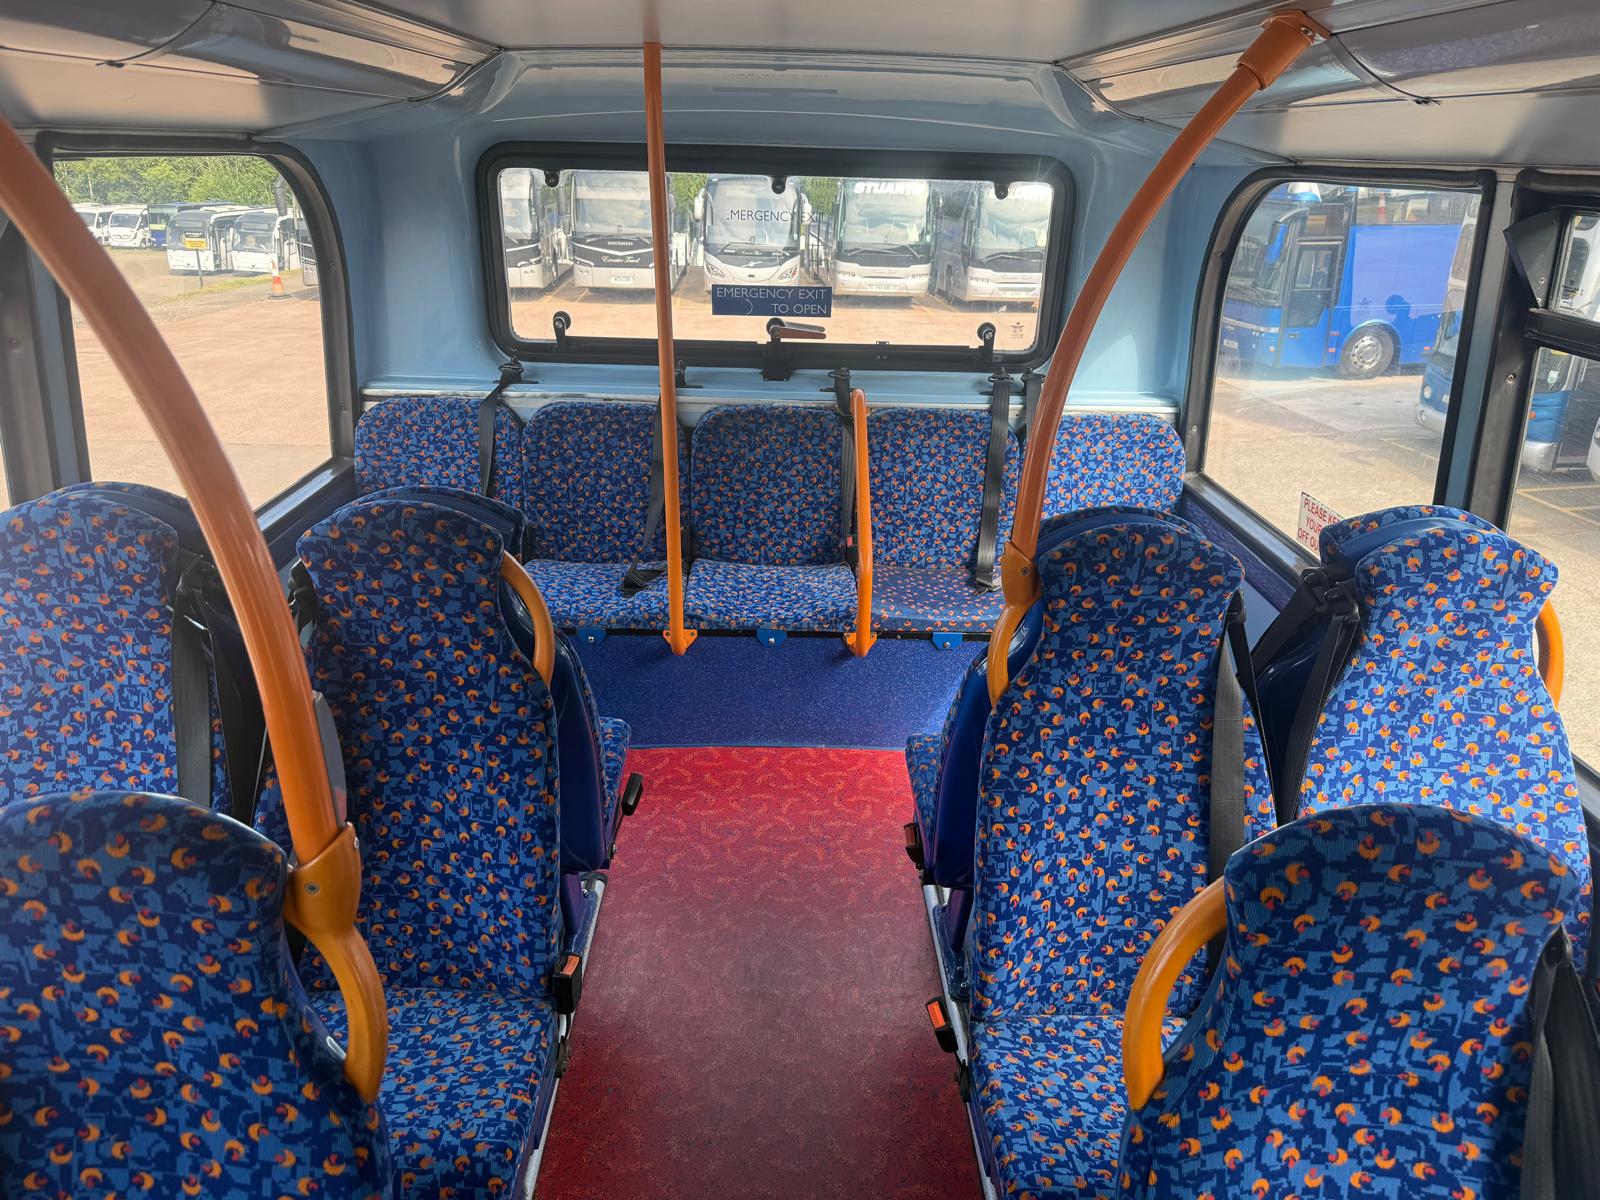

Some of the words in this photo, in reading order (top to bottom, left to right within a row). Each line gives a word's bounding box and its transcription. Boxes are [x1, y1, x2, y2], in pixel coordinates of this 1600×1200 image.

[726, 210, 796, 221] MERGENCY
[801, 211, 824, 222] EXIT
[716, 287, 794, 299] EMERGENCY
[799, 289, 827, 299] EXIT
[771, 303, 789, 313] TO
[793, 304, 827, 314] OPEN
[1304, 498, 1327, 522] PLEASE
[1298, 528, 1309, 542] OFF
